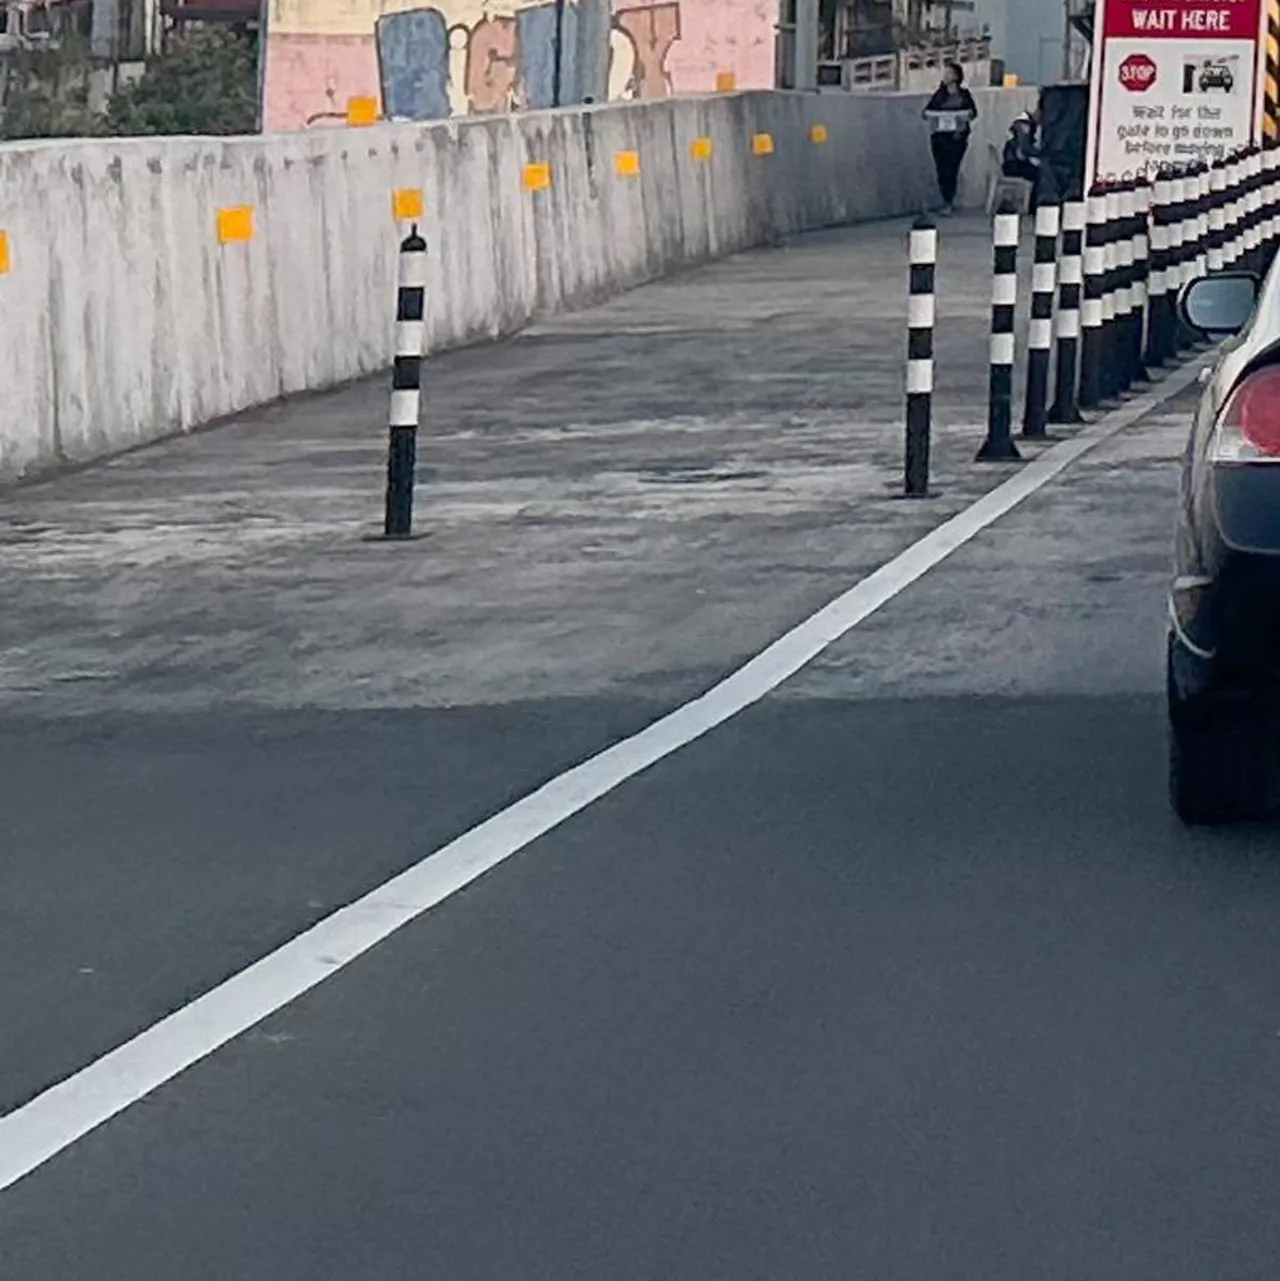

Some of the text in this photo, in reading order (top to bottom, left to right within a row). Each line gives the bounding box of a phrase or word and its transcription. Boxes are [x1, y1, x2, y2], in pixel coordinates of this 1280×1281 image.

[1131, 9, 1232, 31] WAIT HERE
[1121, 64, 1155, 81] STOP
[1171, 104, 1192, 118] for
[1193, 123, 1234, 138] down
